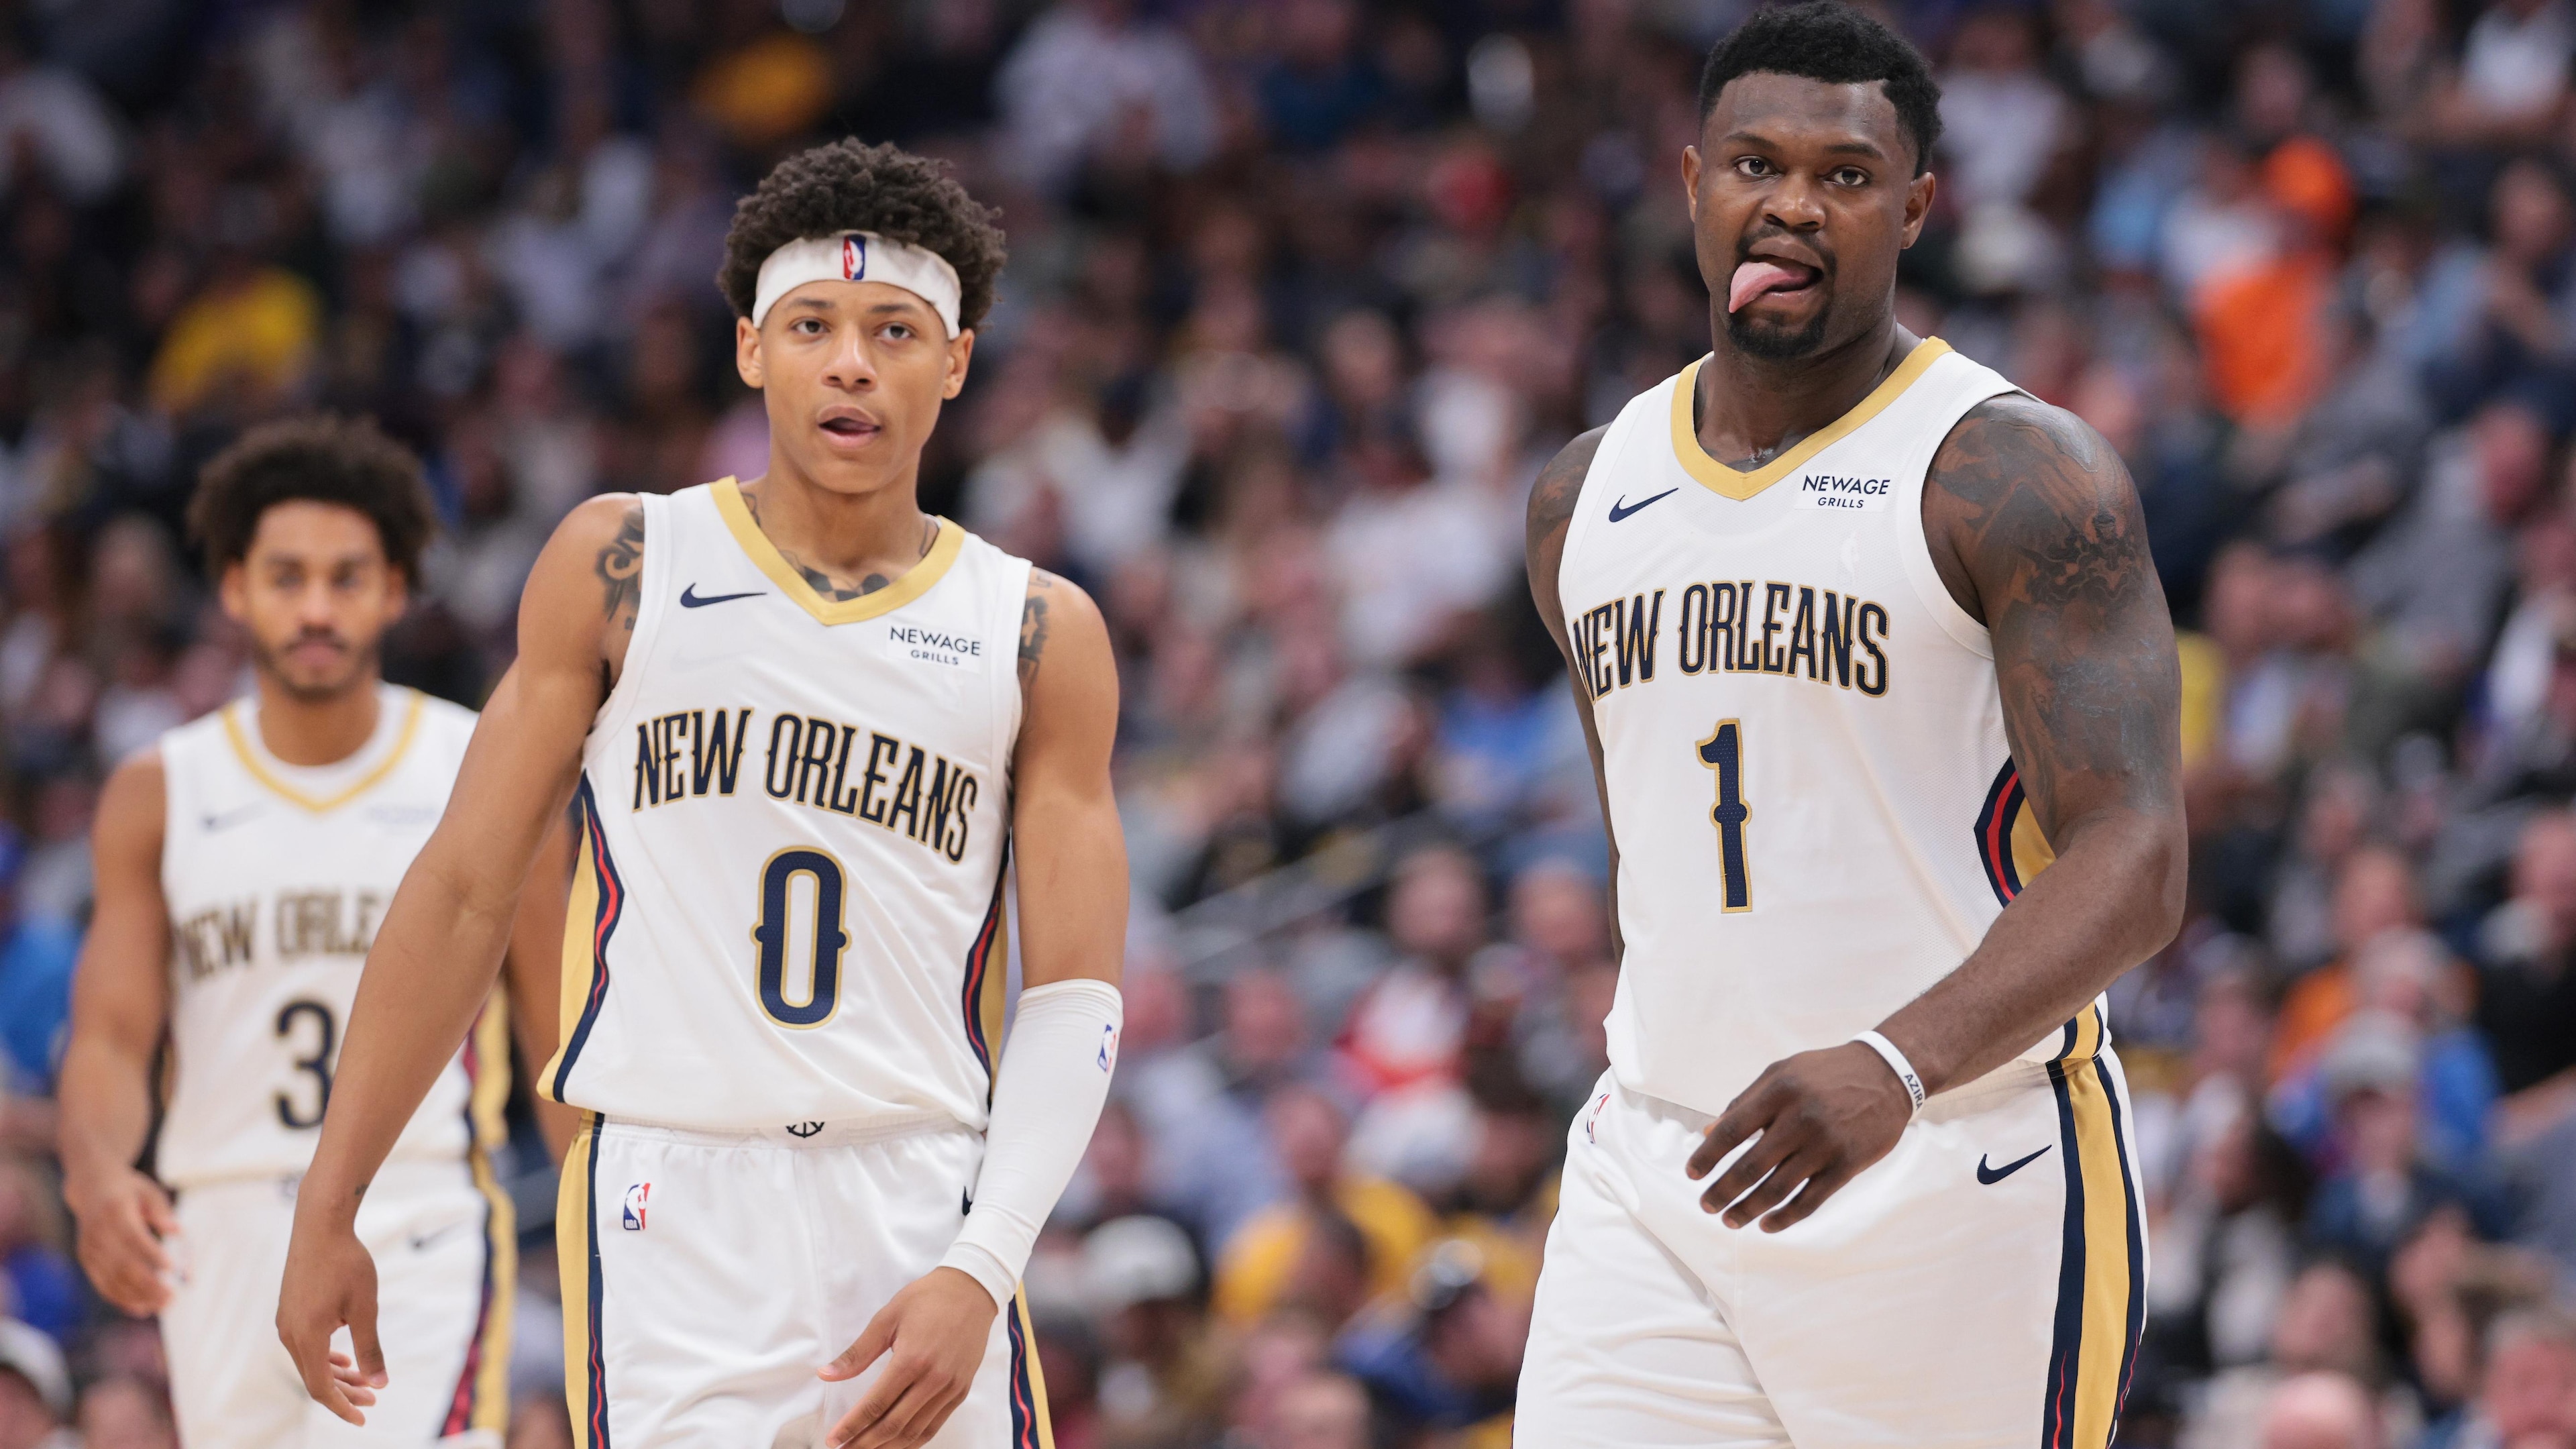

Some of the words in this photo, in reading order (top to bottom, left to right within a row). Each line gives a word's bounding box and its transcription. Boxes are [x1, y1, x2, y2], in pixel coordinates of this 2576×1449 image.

[1803, 474, 1890, 495] NEWAGE
[1818, 496, 1864, 508] GRILLS
[890, 626, 981, 656] NEWAGE
[910, 649, 959, 665] GRILLS
[1572, 588, 1666, 706] NEW
[1678, 580, 1890, 698] ORLEANS
[632, 707, 754, 813] NEW
[763, 712, 978, 865] ORLEANS
[1695, 718, 1753, 914] 1
[749, 845, 852, 1030] 0
[274, 993, 335, 1132] 3
